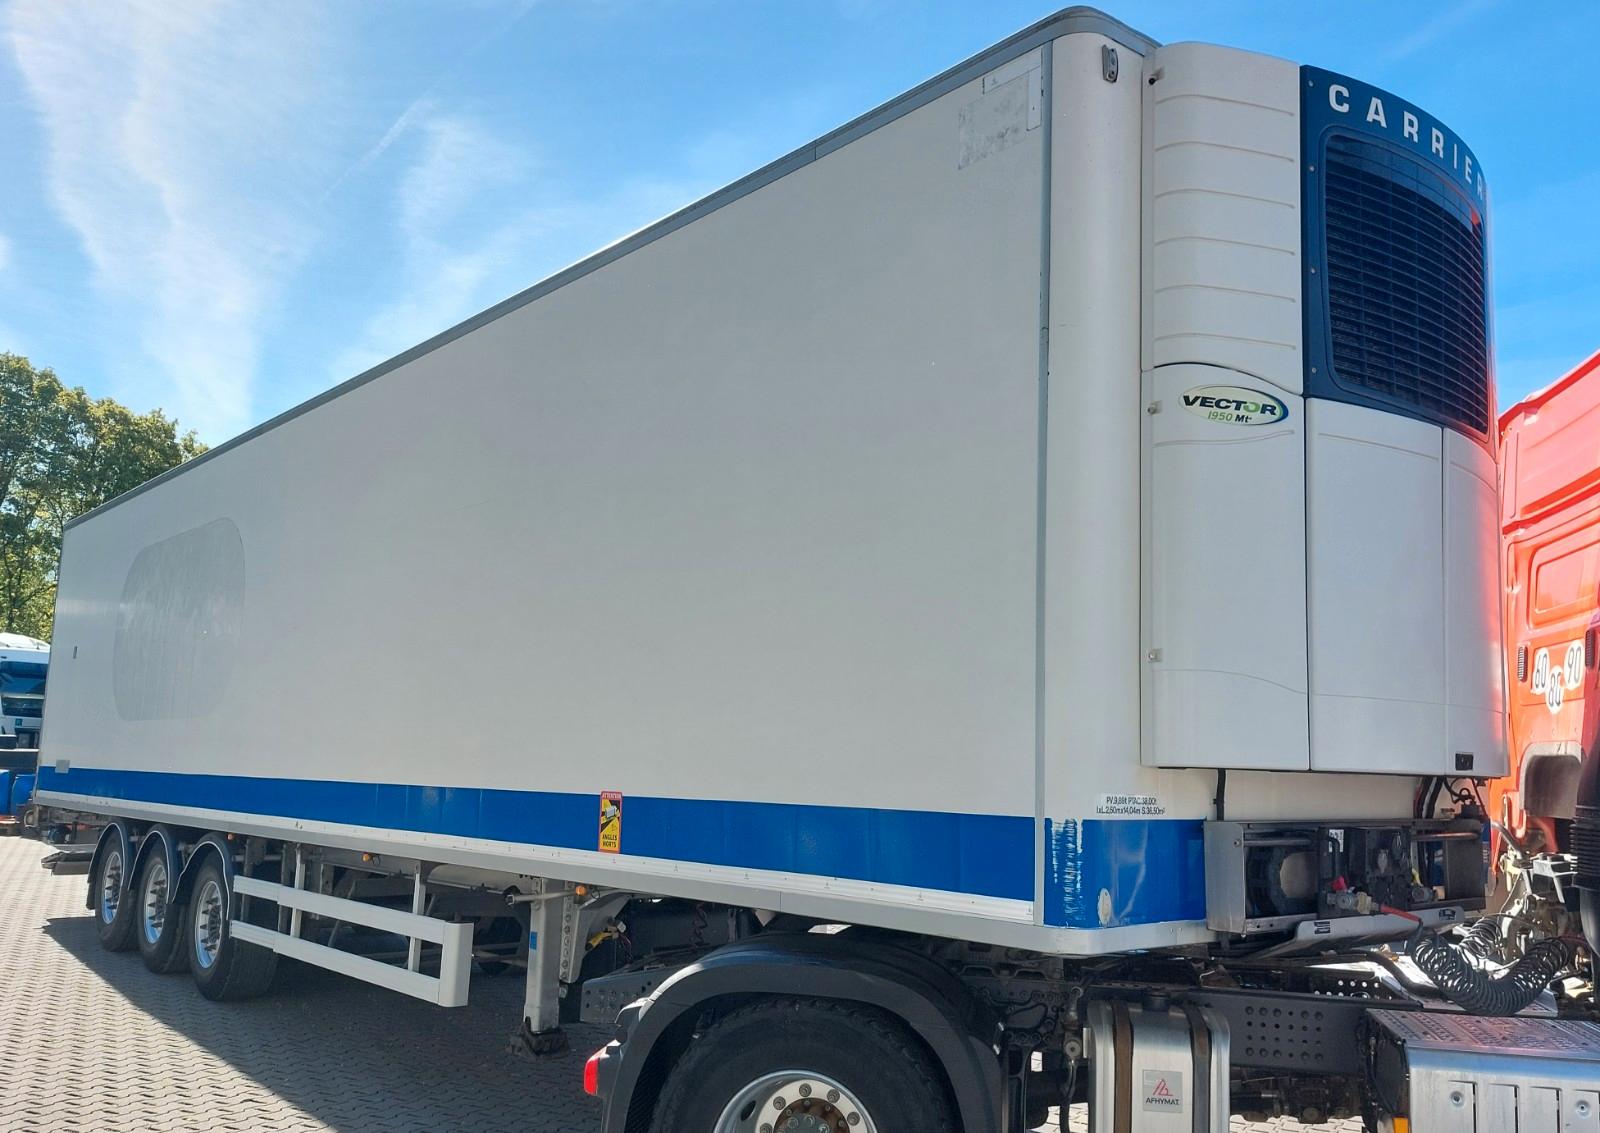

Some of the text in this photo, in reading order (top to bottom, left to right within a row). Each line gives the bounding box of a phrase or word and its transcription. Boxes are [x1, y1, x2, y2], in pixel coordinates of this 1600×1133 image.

[1328, 84, 1484, 200] CARRIER
[1183, 395, 1277, 416] VECTOR
[1207, 411, 1233, 422] 1950
[1535, 653, 1548, 688] 60
[1567, 646, 1582, 683] 90
[1146, 1097, 1180, 1105] AFHYMAT
